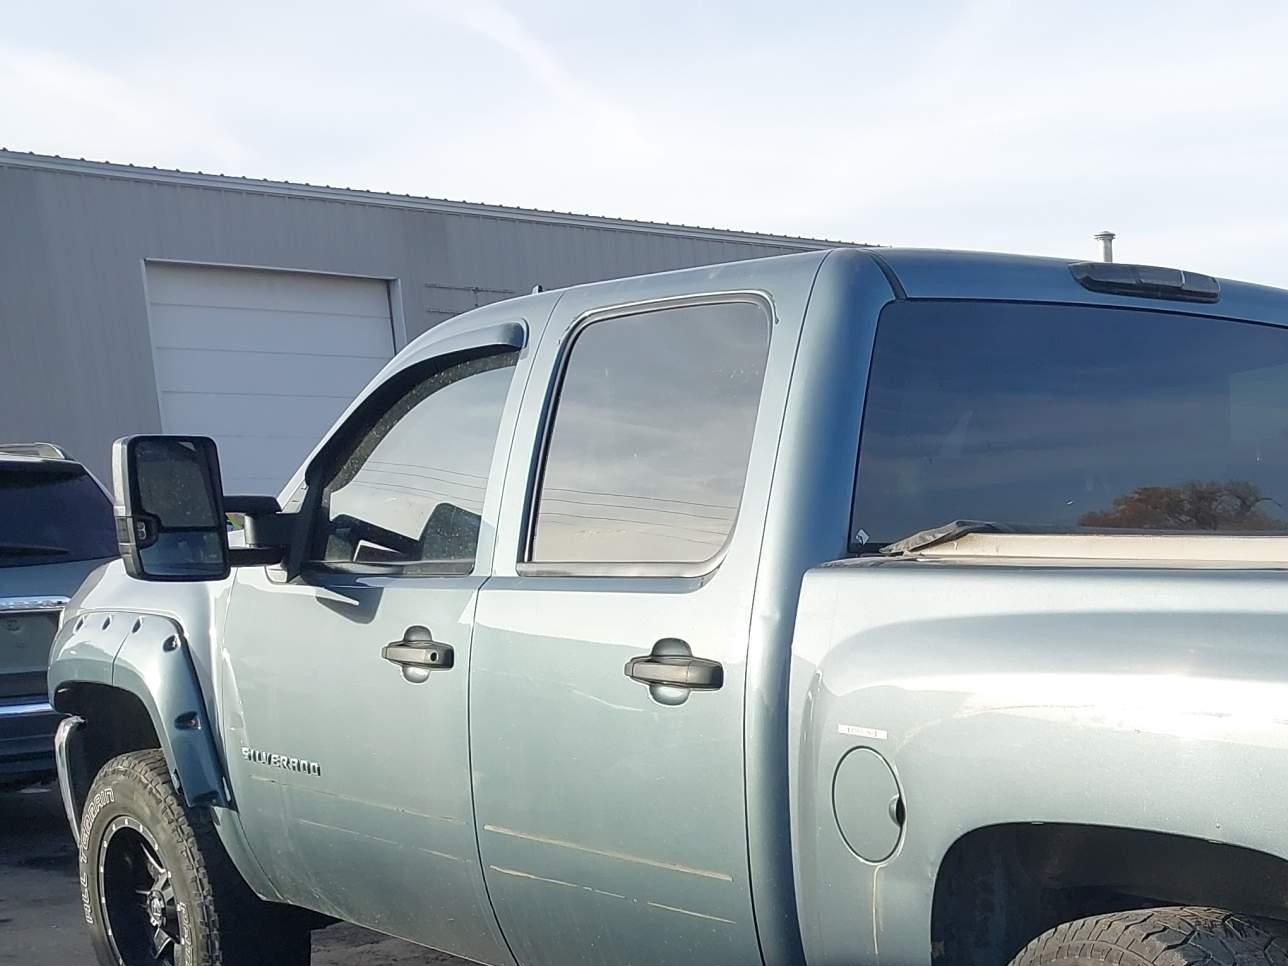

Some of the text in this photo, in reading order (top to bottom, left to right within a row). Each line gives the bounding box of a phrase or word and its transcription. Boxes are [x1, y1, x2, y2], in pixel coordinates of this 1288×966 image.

[241, 747, 321, 776] SILVERADO
[79, 787, 115, 925] ALL TERRAIN
